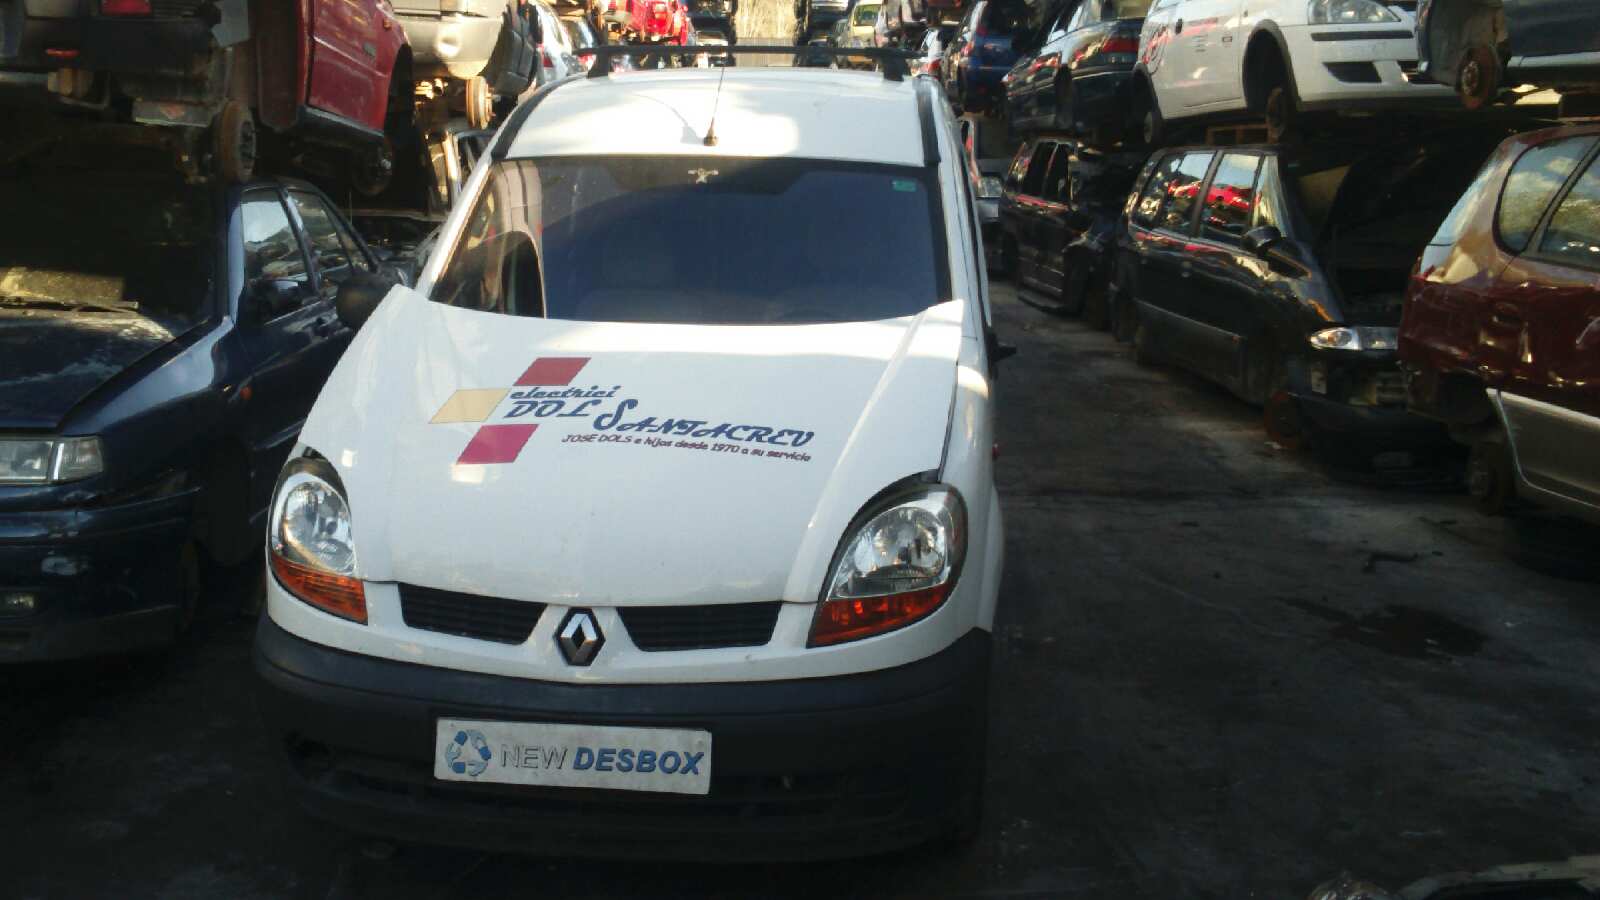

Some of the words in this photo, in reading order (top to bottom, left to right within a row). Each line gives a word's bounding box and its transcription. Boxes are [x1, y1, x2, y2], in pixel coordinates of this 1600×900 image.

[598, 434, 632, 443] DOLS
[674, 441, 709, 450] desde
[710, 443, 740, 454] 1970
[500, 743, 568, 769] NEW
[572, 746, 704, 776] DESBOX
